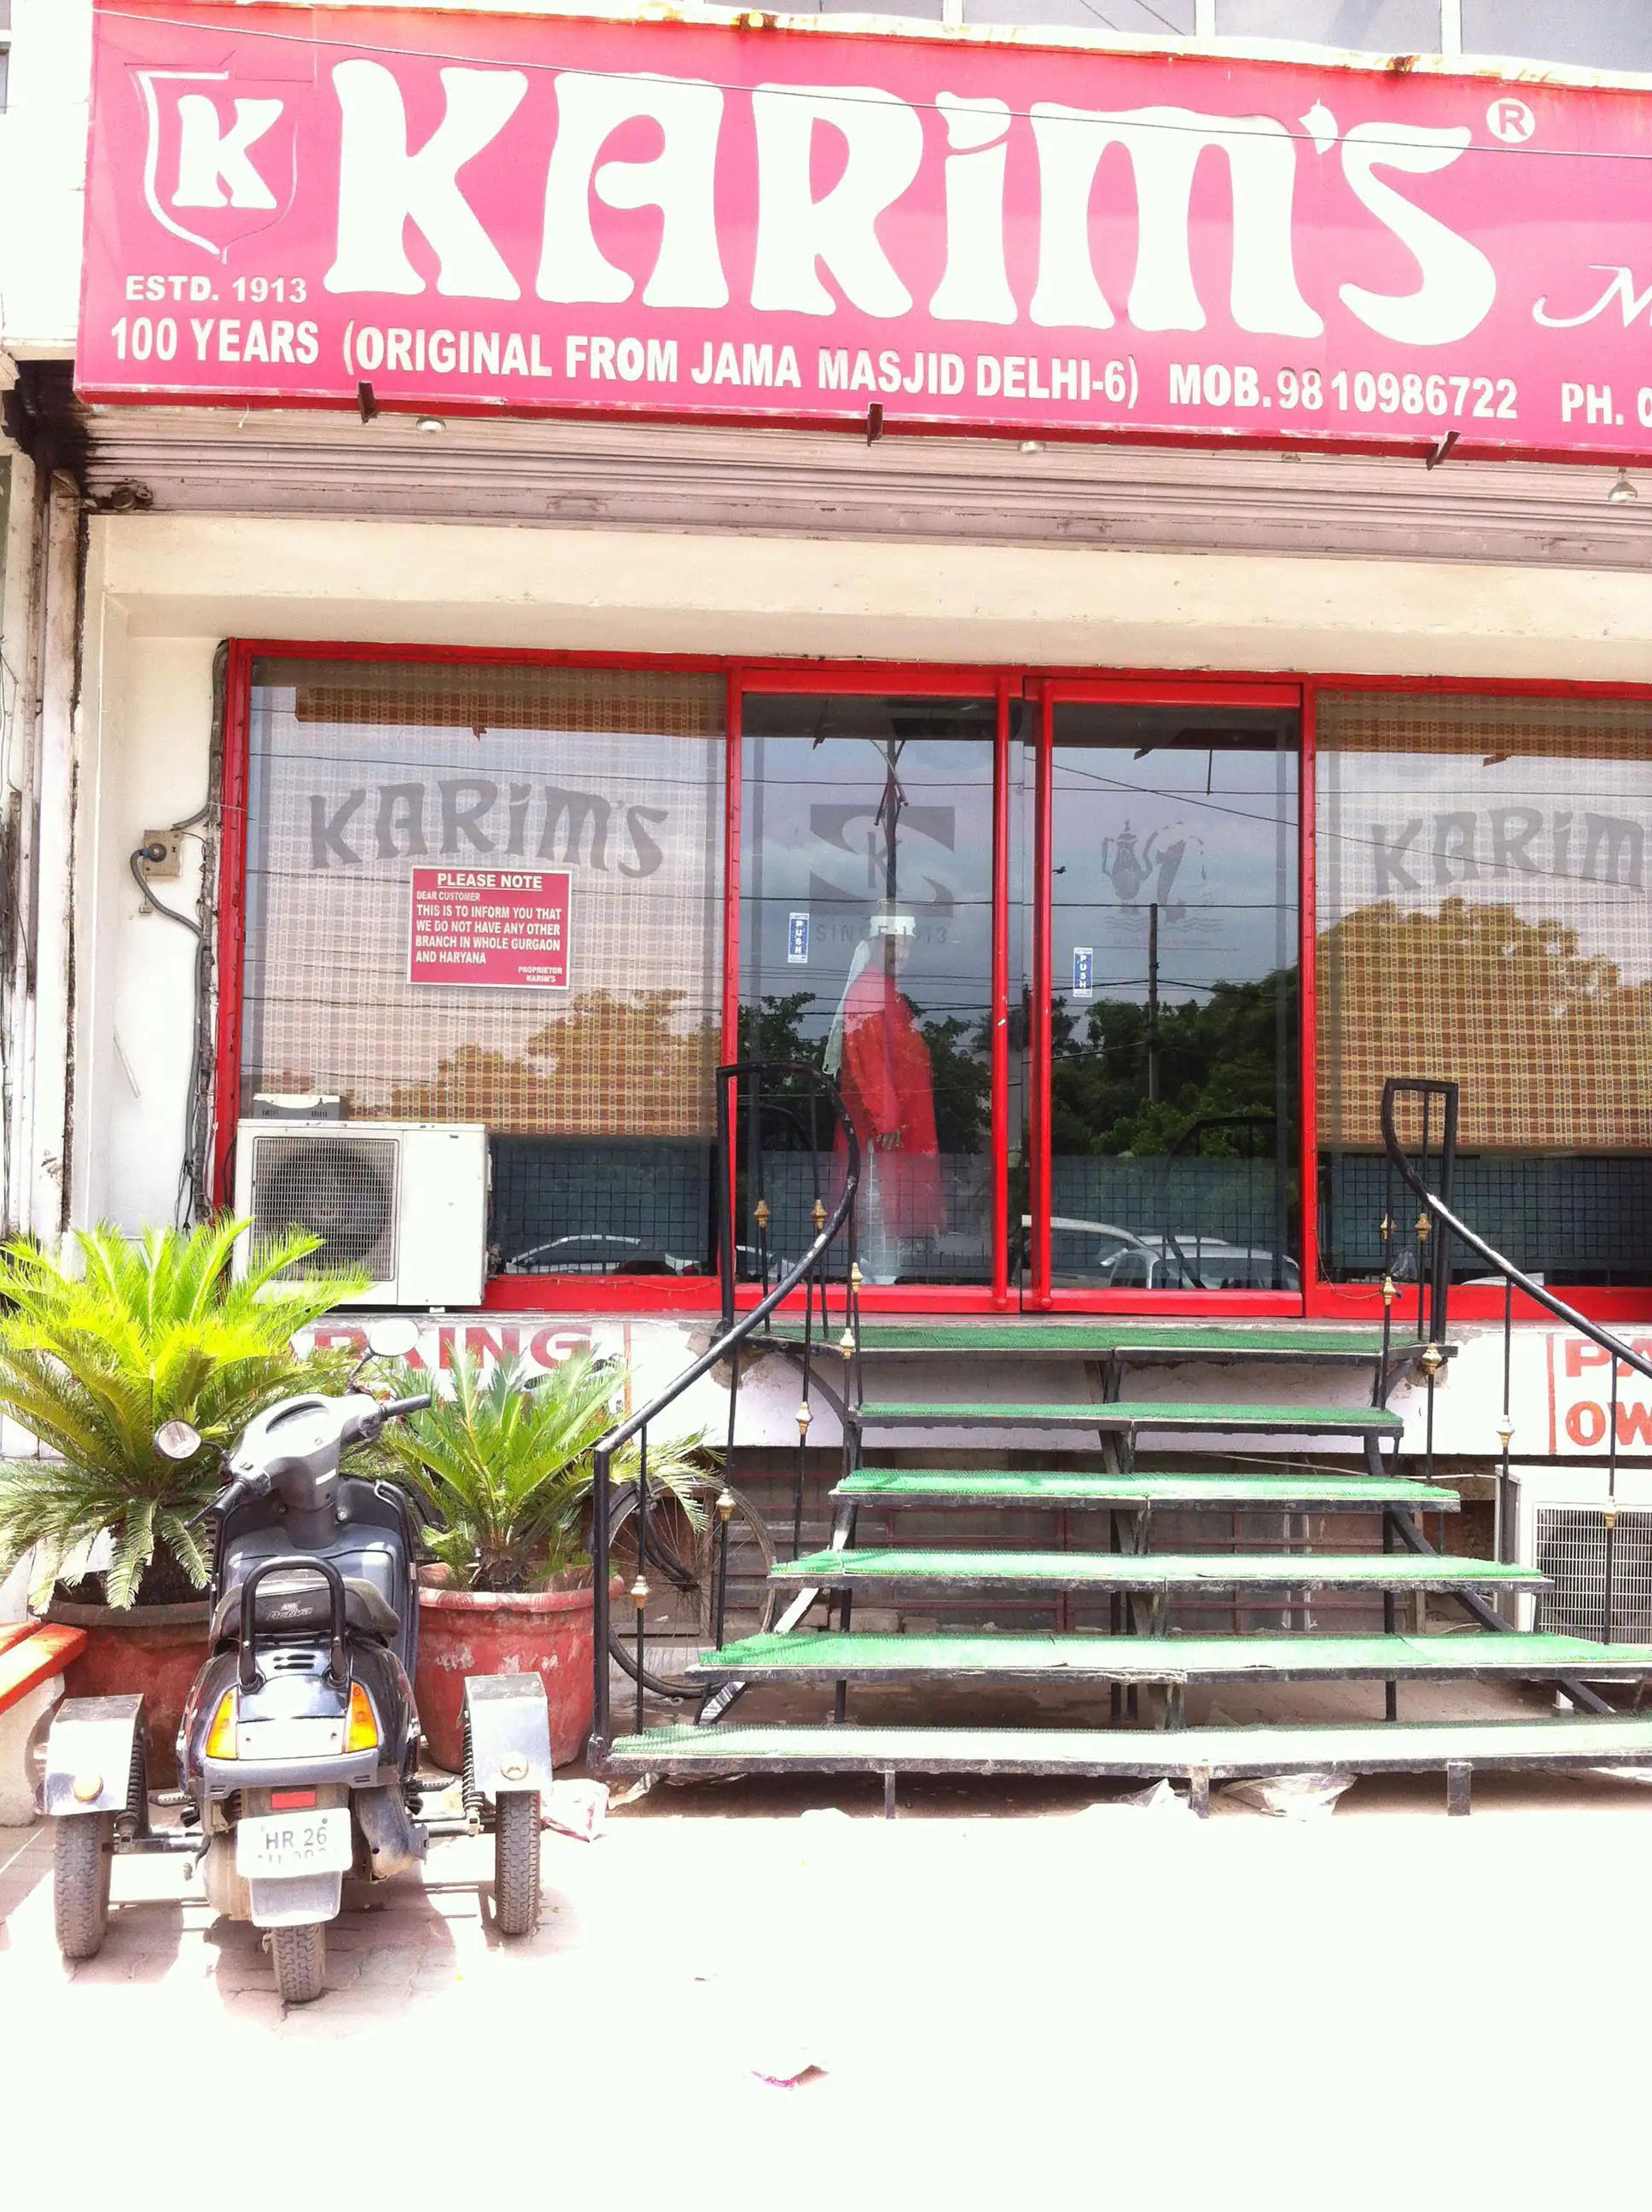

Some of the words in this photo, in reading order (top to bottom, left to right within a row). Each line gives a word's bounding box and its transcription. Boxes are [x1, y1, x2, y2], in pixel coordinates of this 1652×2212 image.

[172, 94, 284, 210] K
[125, 275, 219, 301] ESTD.
[231, 276, 307, 303] 1913
[111, 317, 177, 363] 100
[189, 318, 319, 365] YEARS
[342, 319, 552, 378] (ORIGINAL
[566, 335, 678, 382] FROM
[691, 341, 801, 388] JAMA
[817, 346, 965, 396] MASJID
[975, 353, 1139, 410] DELHI-6)
[1561, 381, 1625, 426] PH.
[437, 873, 496, 888] PLEASE
[501, 875, 543, 889] NOTE
[416, 891, 437, 901] DEAR
[439, 892, 480, 902] CUSTOMER
[416, 905, 439, 917] THIS
[443, 905, 452, 917] IS
[456, 905, 468, 917] TO
[472, 906, 509, 918] INFORM
[513, 907, 533, 919] YOU
[536, 908, 562, 920] THAT
[416, 920, 432, 932] WE
[434, 921, 448, 932] DO
[451, 921, 472, 933] NOT
[474, 922, 501, 934] HAVE
[503, 923, 525, 934] ANY
[526, 923, 561, 936] OTHER
[416, 935, 457, 948] BRANCH
[460, 937, 470, 948] IN
[474, 937, 508, 949] WHOLE
[511, 938, 561, 951] GURGAON
[794, 920, 803, 954] PUSH
[416, 951, 437, 963] AND
[439, 952, 486, 964] HARYANA
[518, 966, 563, 975] PROPRIETOR
[1079, 955, 1087, 989] PUSH
[265, 1830, 294, 1850] HR
[303, 1825, 328, 1847] 26
